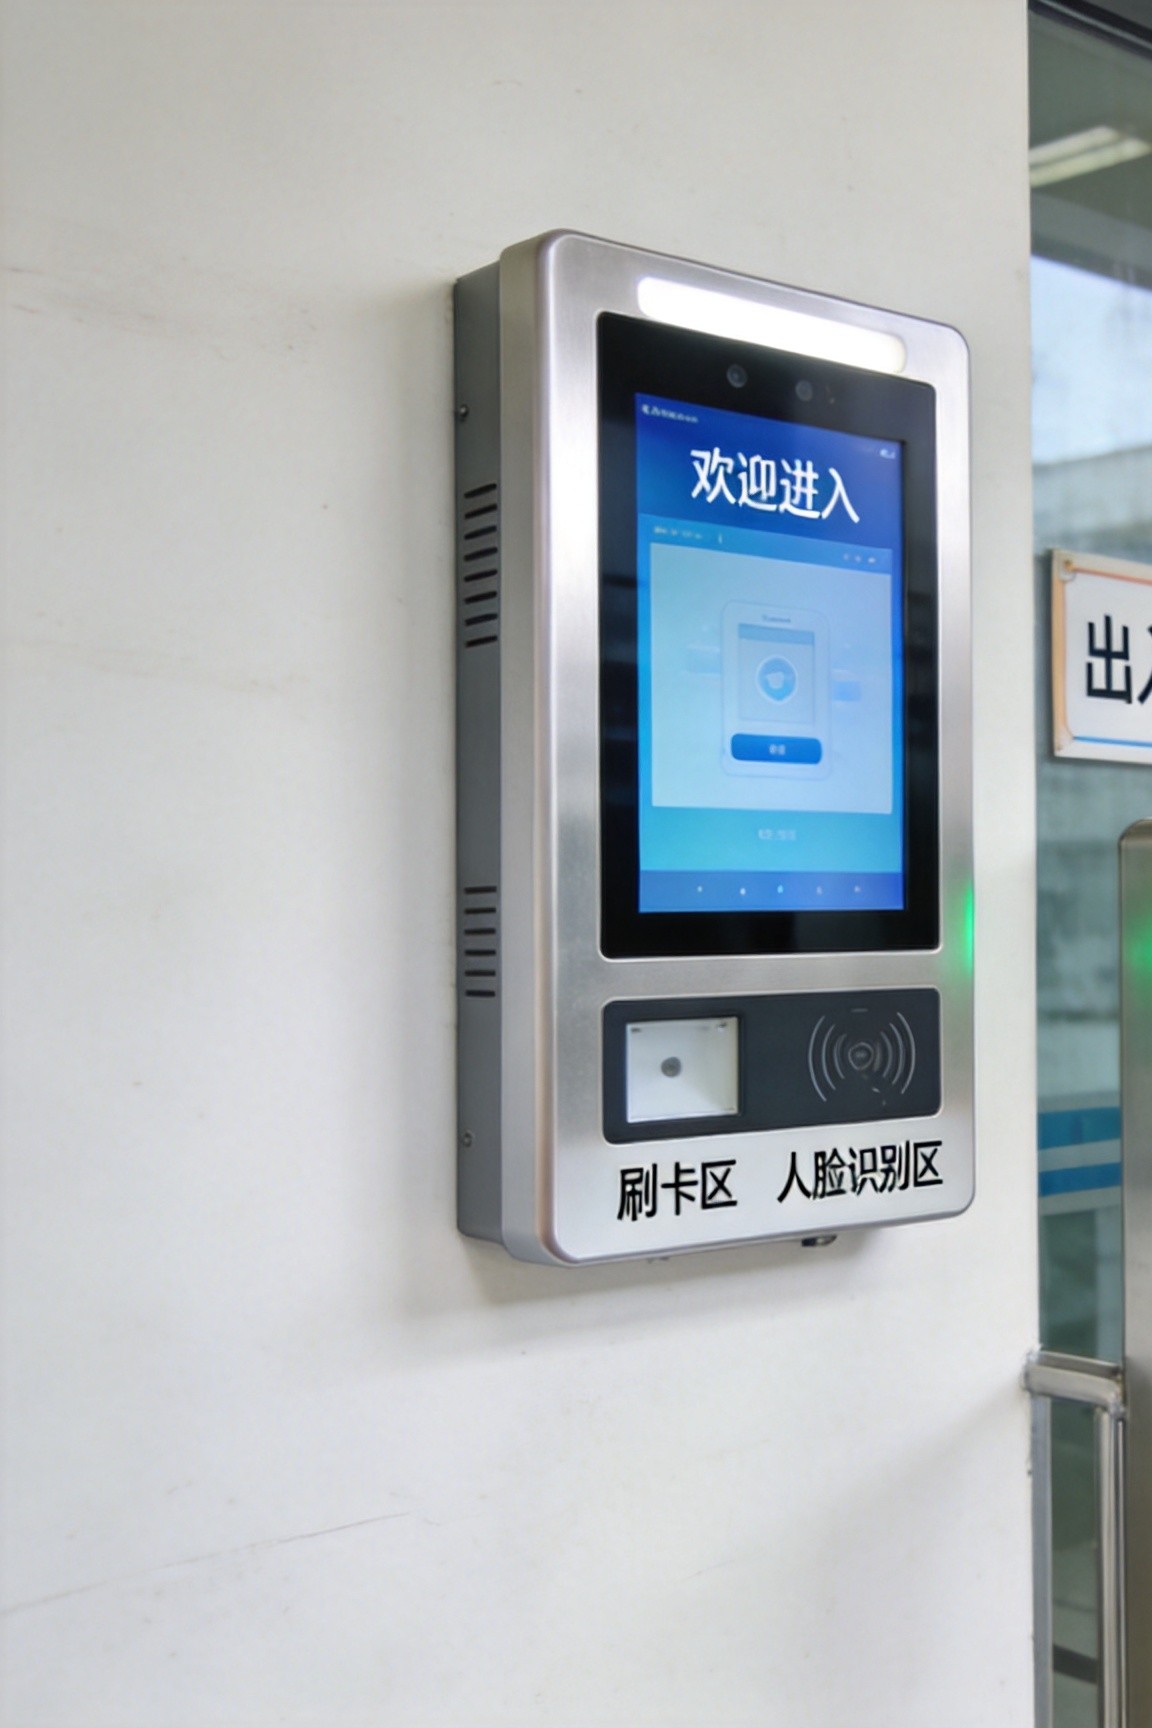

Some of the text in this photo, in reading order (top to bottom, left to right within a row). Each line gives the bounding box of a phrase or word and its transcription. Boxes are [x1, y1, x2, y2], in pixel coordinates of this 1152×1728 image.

[690, 447, 860, 523] 欢迎进入
[617, 1140, 942, 1221] 刷卡区 人脸识别区
